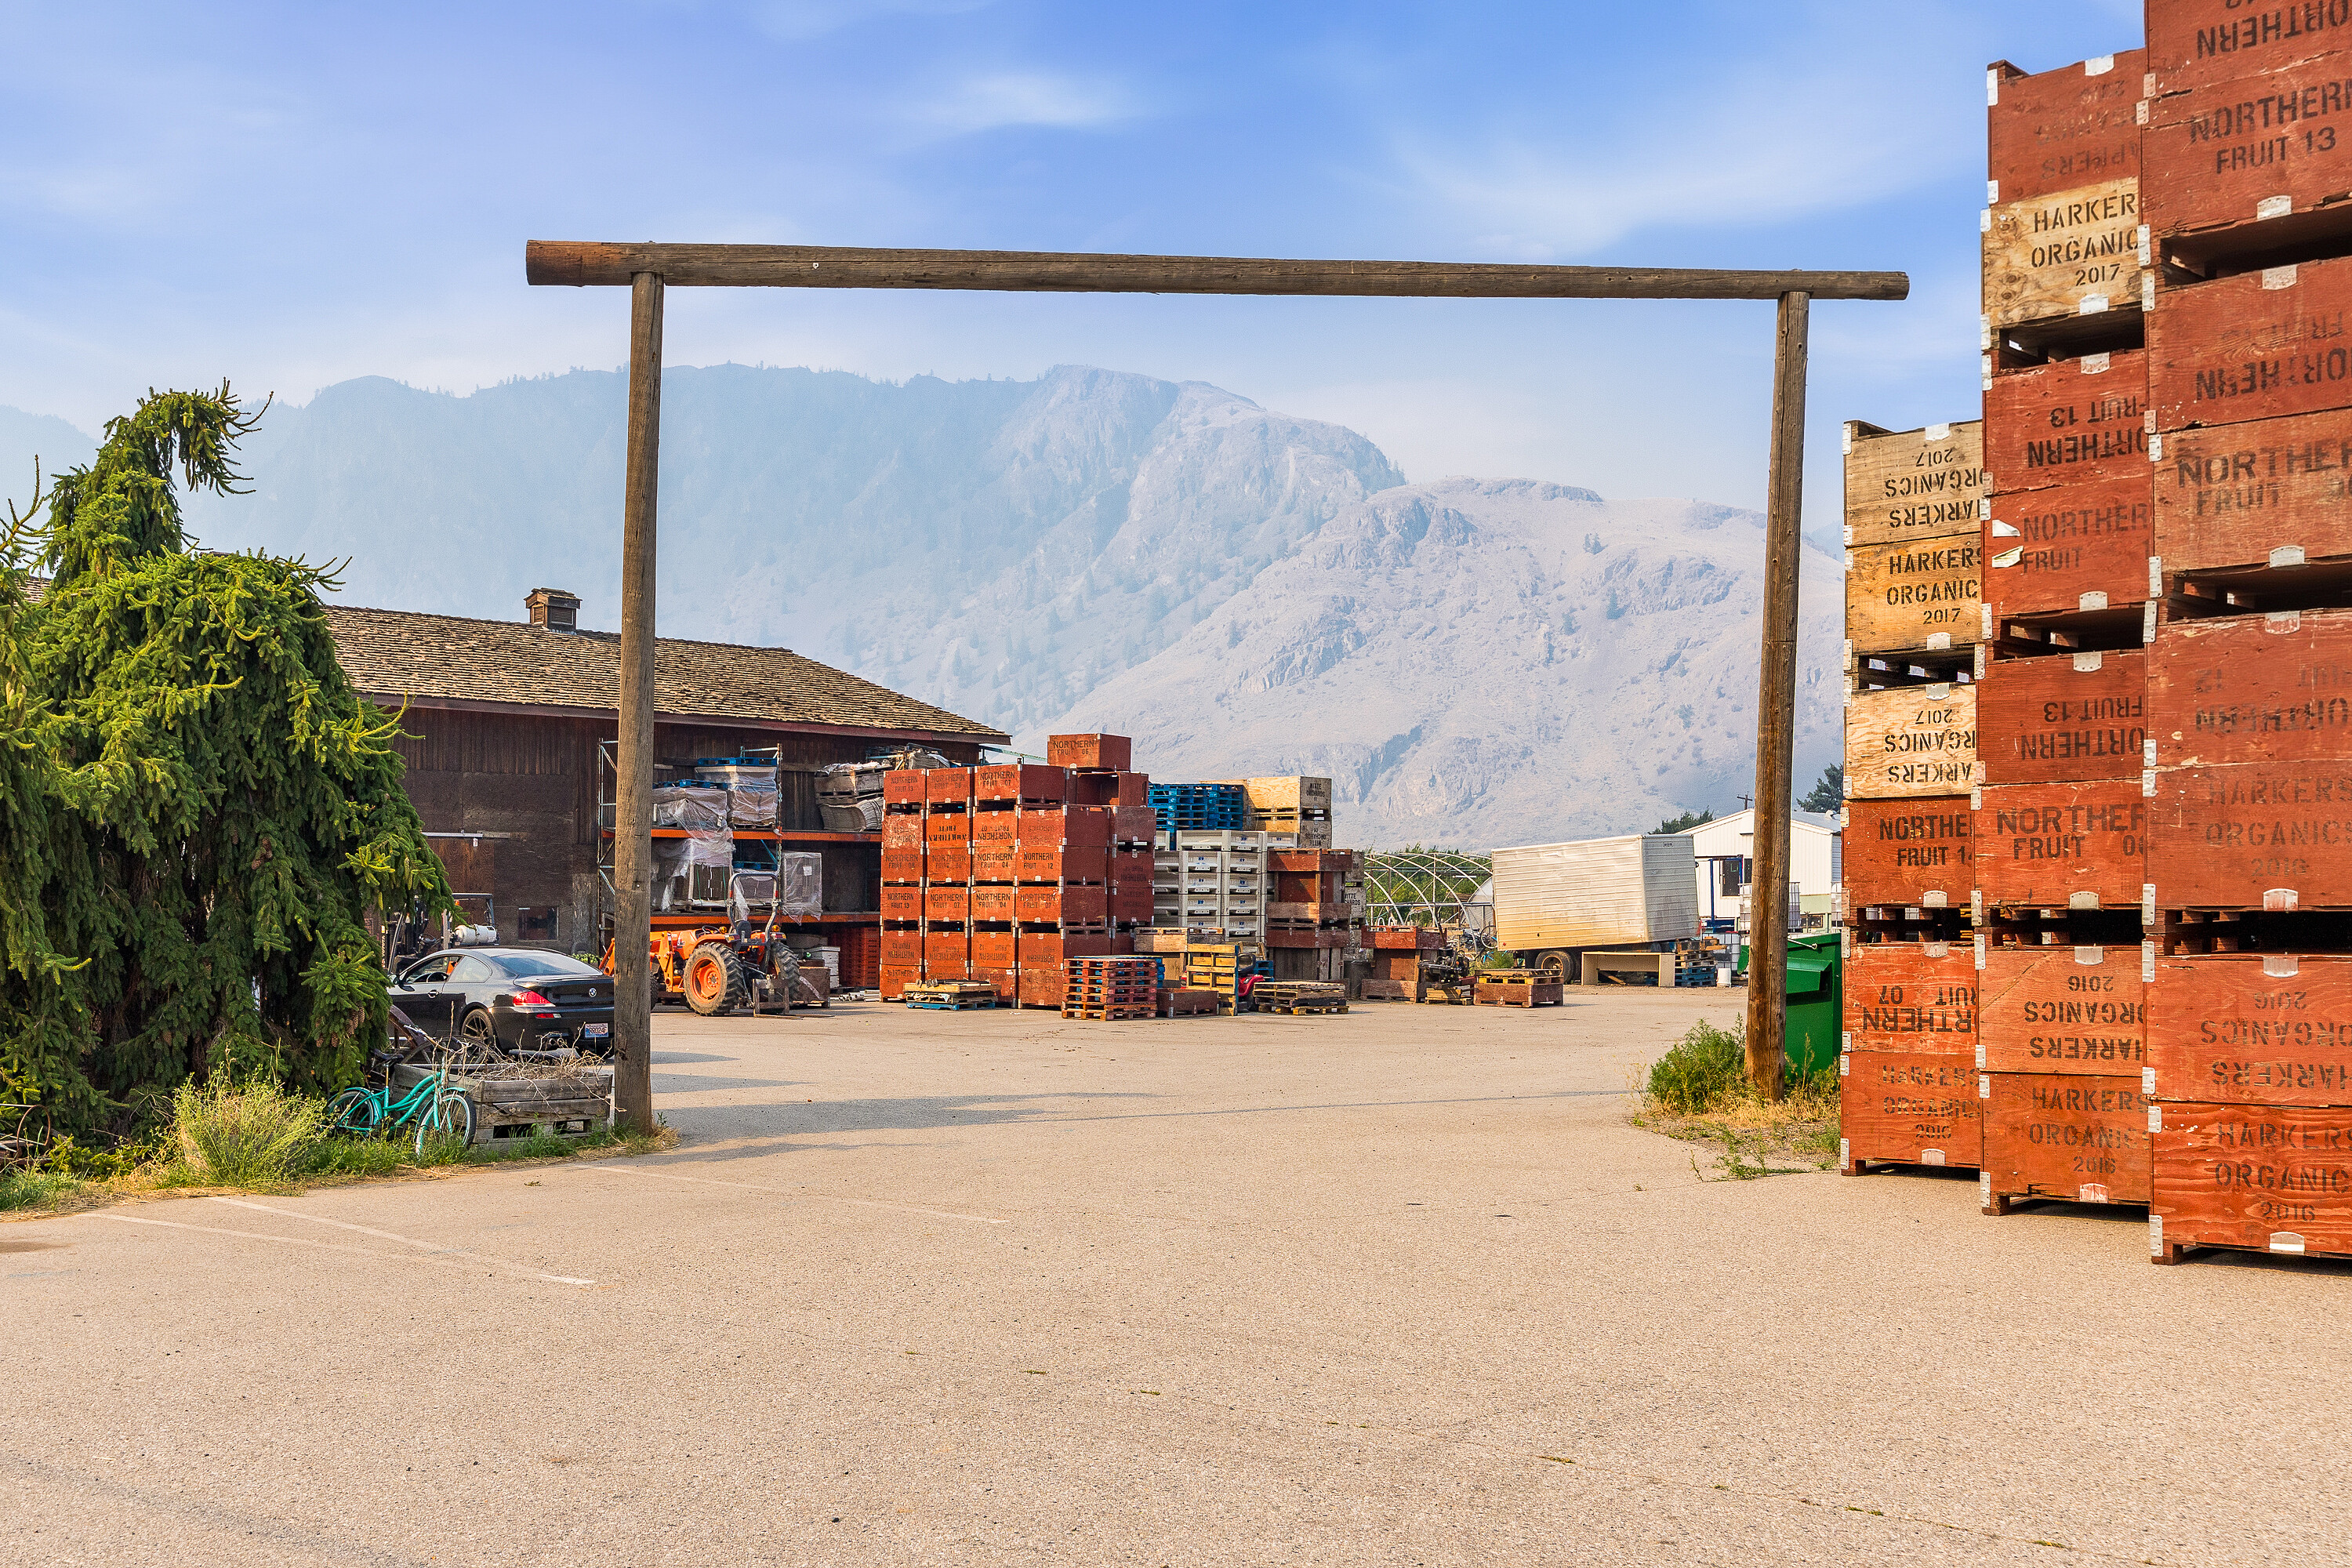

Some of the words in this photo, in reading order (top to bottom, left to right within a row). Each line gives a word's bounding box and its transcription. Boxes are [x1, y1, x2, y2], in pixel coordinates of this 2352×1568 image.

[2197, 0, 2349, 59] ORTHERN
[2190, 78, 2352, 144] NORTHER
[2216, 136, 2289, 174] FRUIT
[2305, 126, 2336, 156] 13
[2034, 193, 2136, 233] HARKER
[2031, 228, 2139, 268] ORGANIC
[2075, 263, 2121, 287] 2017
[2197, 347, 2352, 401] ORTHERN
[2050, 406, 2078, 428] 13
[1916, 448, 1953, 466] 2017
[2027, 426, 2149, 468] ORTHERN
[2178, 437, 2352, 488] NORTHE
[2196, 482, 2281, 516] FRUIT
[2024, 503, 2149, 543] NORTHER
[2023, 547, 2081, 573] FRUIT
[1886, 579, 1978, 605] ORGANIC
[1923, 608, 1961, 625] 2017
[1915, 709, 1952, 724] 2017
[2043, 701, 2073, 722] 13
[2082, 695, 2143, 720] FRUIT
[2195, 697, 2349, 733] ORTHERN
[1053, 740, 1094, 749] NORTHERN
[1885, 730, 1976, 753] RGANICS
[2021, 727, 2145, 760] ORTHERN
[891, 775, 918, 784] NORTHERN
[980, 771, 1015, 781] NORTHERN
[1888, 762, 1972, 783] ARKERS
[2208, 775, 2352, 805] HARKERS
[1879, 813, 1972, 840] NORTHE
[1997, 804, 2144, 835] NORTHER
[977, 852, 1013, 861] NORTHERN
[1023, 852, 1054, 861] NORTHERN
[1897, 846, 1949, 866] FRUIT
[1958, 845, 1972, 865] 1
[2013, 836, 2085, 859] FRUIT
[2122, 834, 2144, 856] 0
[885, 854, 919, 862] NORTHERN
[930, 893, 964, 902] NORTHERN
[978, 953, 1007, 961] NORTHERN
[1026, 954, 1055, 963] NORTHERN
[978, 973, 1007, 982] NORTHERN
[2068, 975, 2114, 992] 2016
[1878, 985, 1903, 1004] 07
[2254, 992, 2307, 1010] 2016
[1863, 1007, 1973, 1033] RTHERN
[1882, 1065, 1980, 1087] HARKERS
[1883, 1096, 1980, 1118] ORGANIC
[2031, 1087, 2149, 1113] HARKERS
[2073, 1156, 2116, 1174] 2016
[2215, 1163, 2350, 1193] ORGANIC
[2261, 1201, 2315, 1221] 2016
